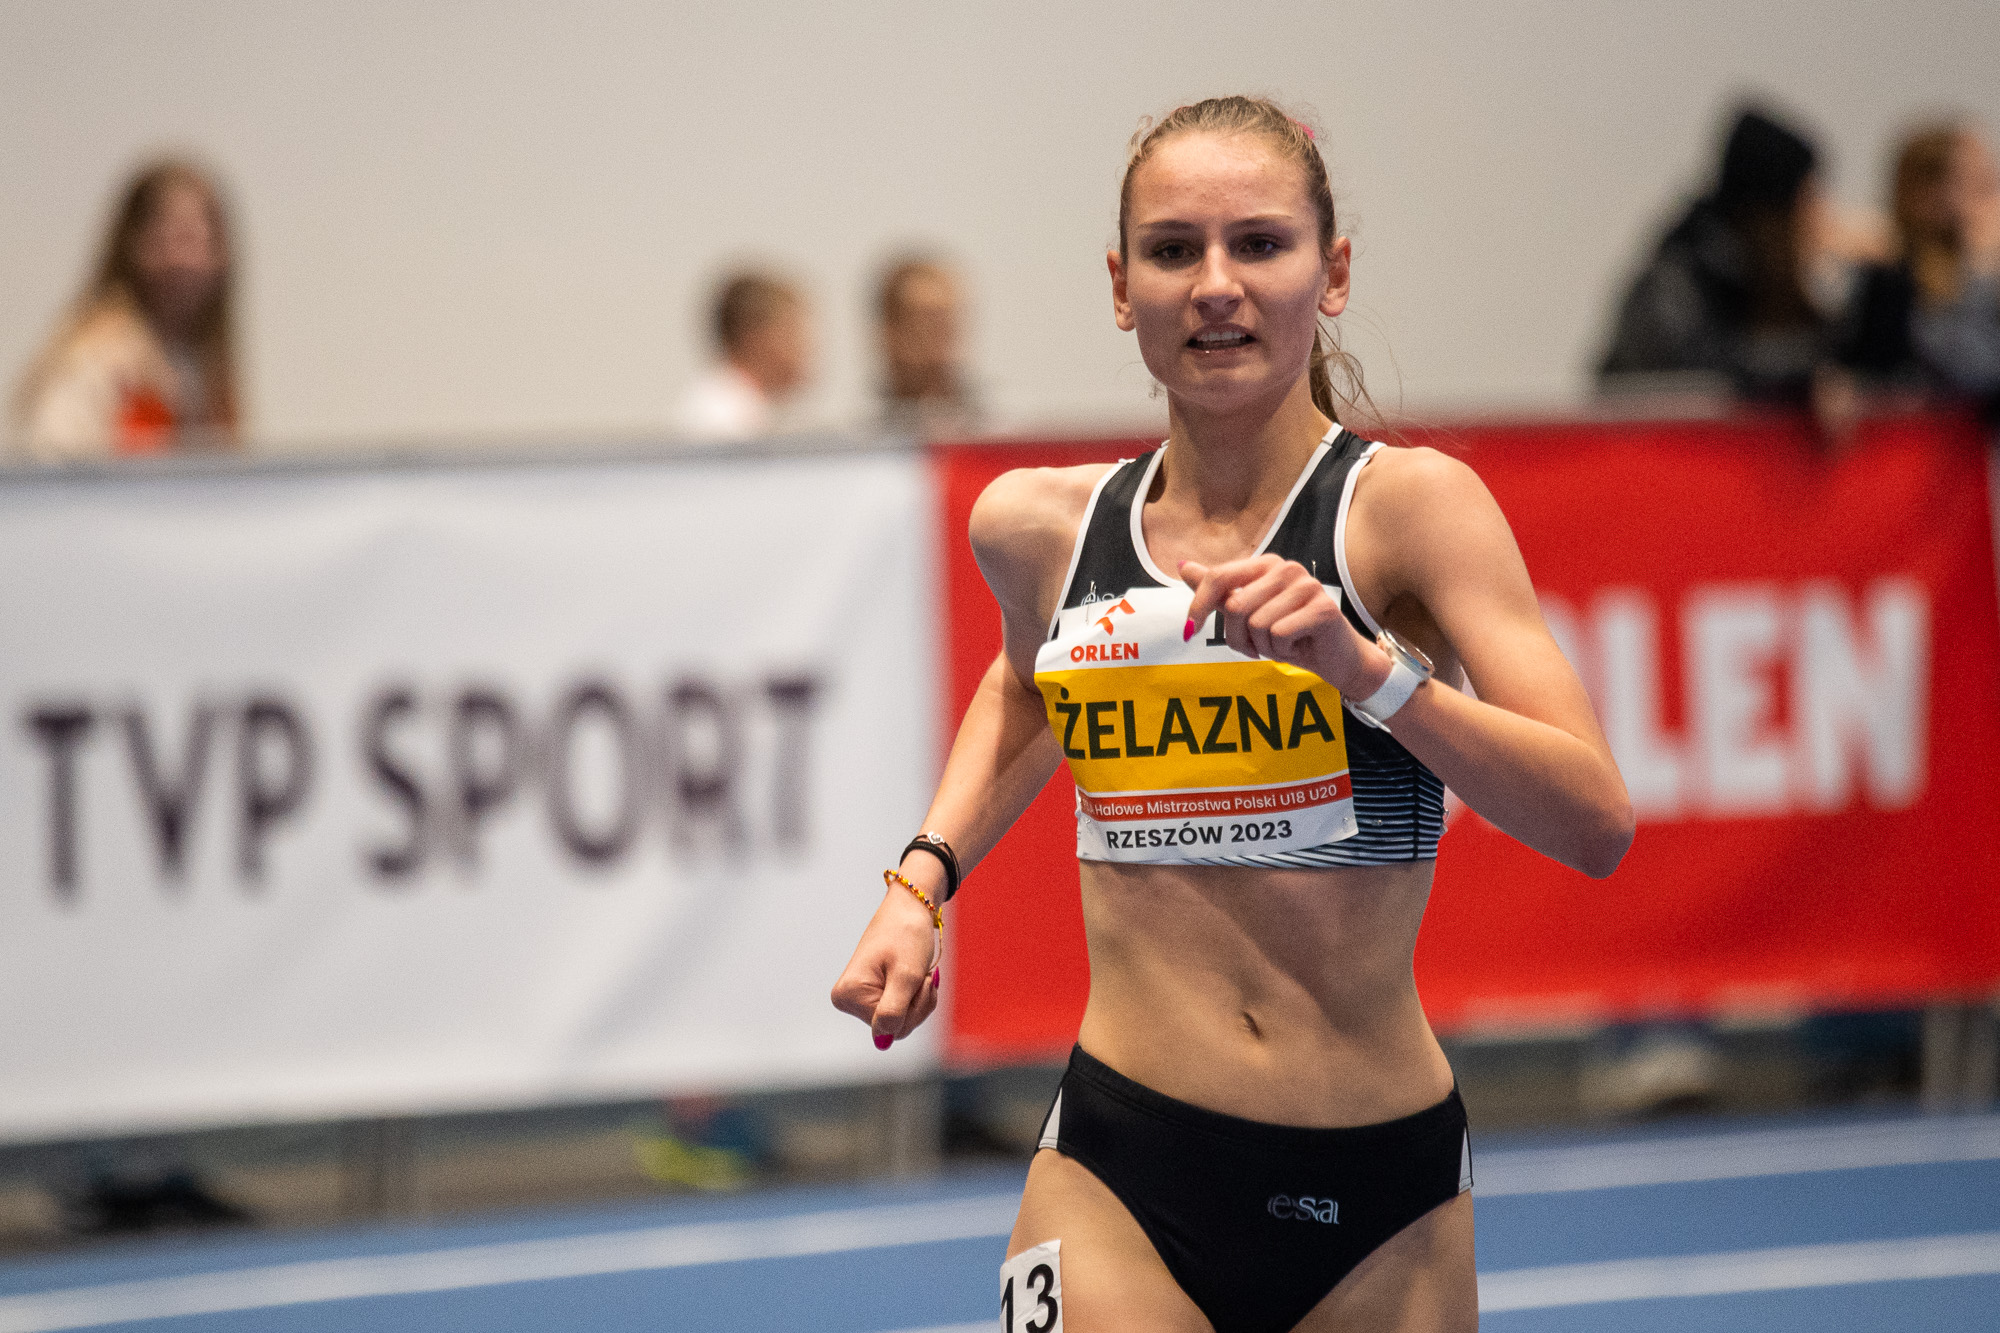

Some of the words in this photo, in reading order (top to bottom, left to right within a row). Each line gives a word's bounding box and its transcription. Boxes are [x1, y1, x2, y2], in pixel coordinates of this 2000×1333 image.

[1070, 642, 1139, 663] ORLEN
[1055, 687, 1336, 760] ŻELAZNA
[1541, 584, 1928, 814] LEN
[22, 685, 315, 905] TVP
[358, 668, 826, 885] SPORT
[1095, 804, 1144, 817] Halowe
[1147, 797, 1231, 814] Mistrzostwa
[1234, 794, 1277, 810] Polski
[1280, 791, 1306, 807] U18
[1309, 784, 1338, 801] U20
[1106, 820, 1223, 849] RZESZÓW
[1230, 819, 1293, 843] 2023
[1001, 1263, 1059, 1333] 13
